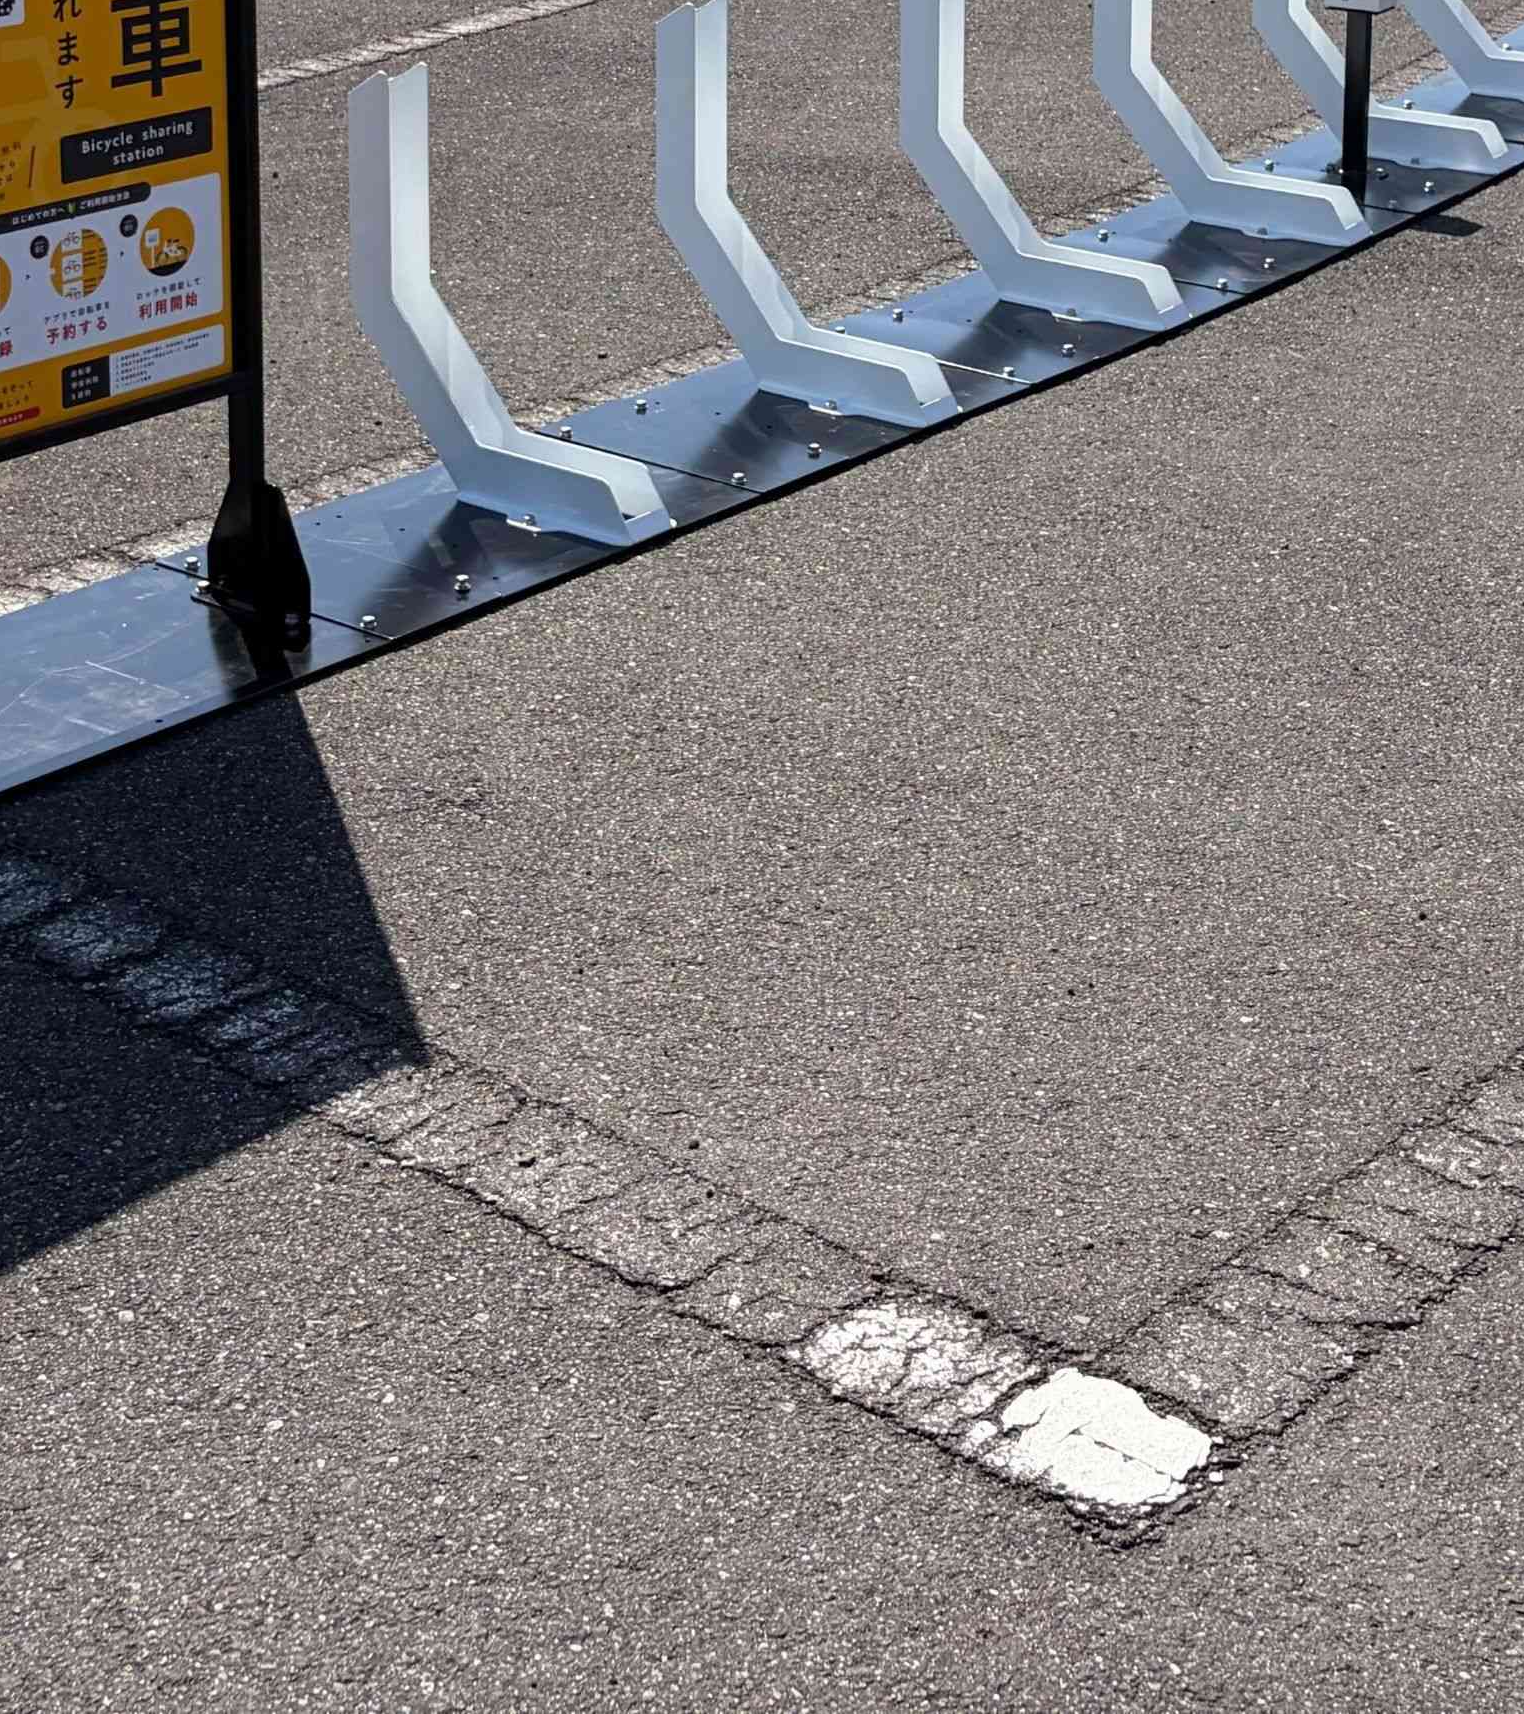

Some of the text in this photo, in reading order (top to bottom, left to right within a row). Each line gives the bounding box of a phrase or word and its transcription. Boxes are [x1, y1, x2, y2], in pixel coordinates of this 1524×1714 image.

[81, 120, 194, 154] Bicycle sharing
[112, 145, 165, 166] station
[138, 291, 199, 320] 利用開始
[46, 316, 108, 345] 予約する
